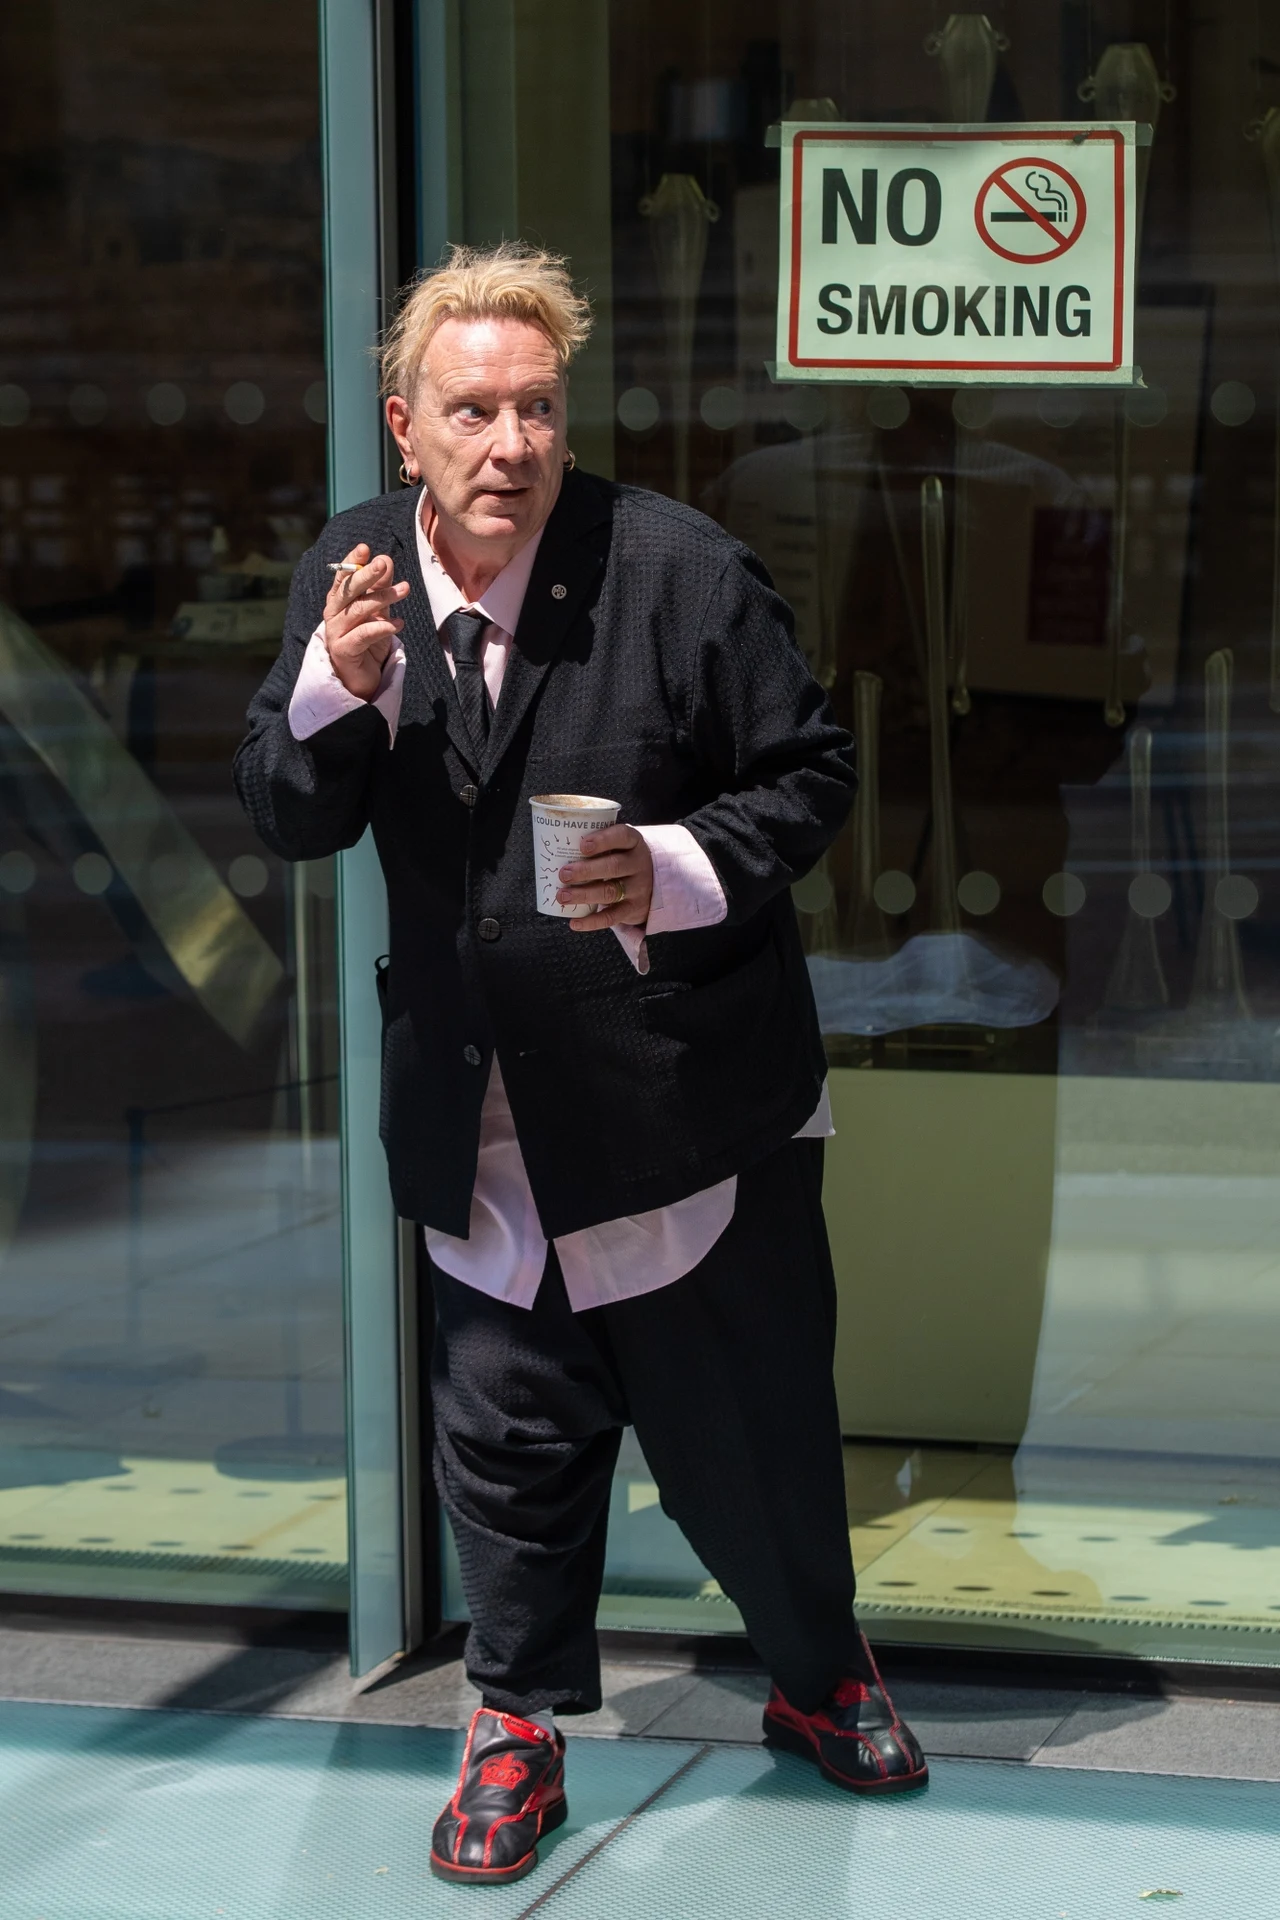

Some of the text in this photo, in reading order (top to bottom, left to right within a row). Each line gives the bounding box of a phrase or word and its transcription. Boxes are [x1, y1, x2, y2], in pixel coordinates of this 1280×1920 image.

[821, 167, 942, 247] NO
[817, 282, 1092, 338] SMOKING
[536, 816, 561, 827] COULD
[563, 820, 588, 829] HAVE
[590, 821, 609, 829] BEEN
